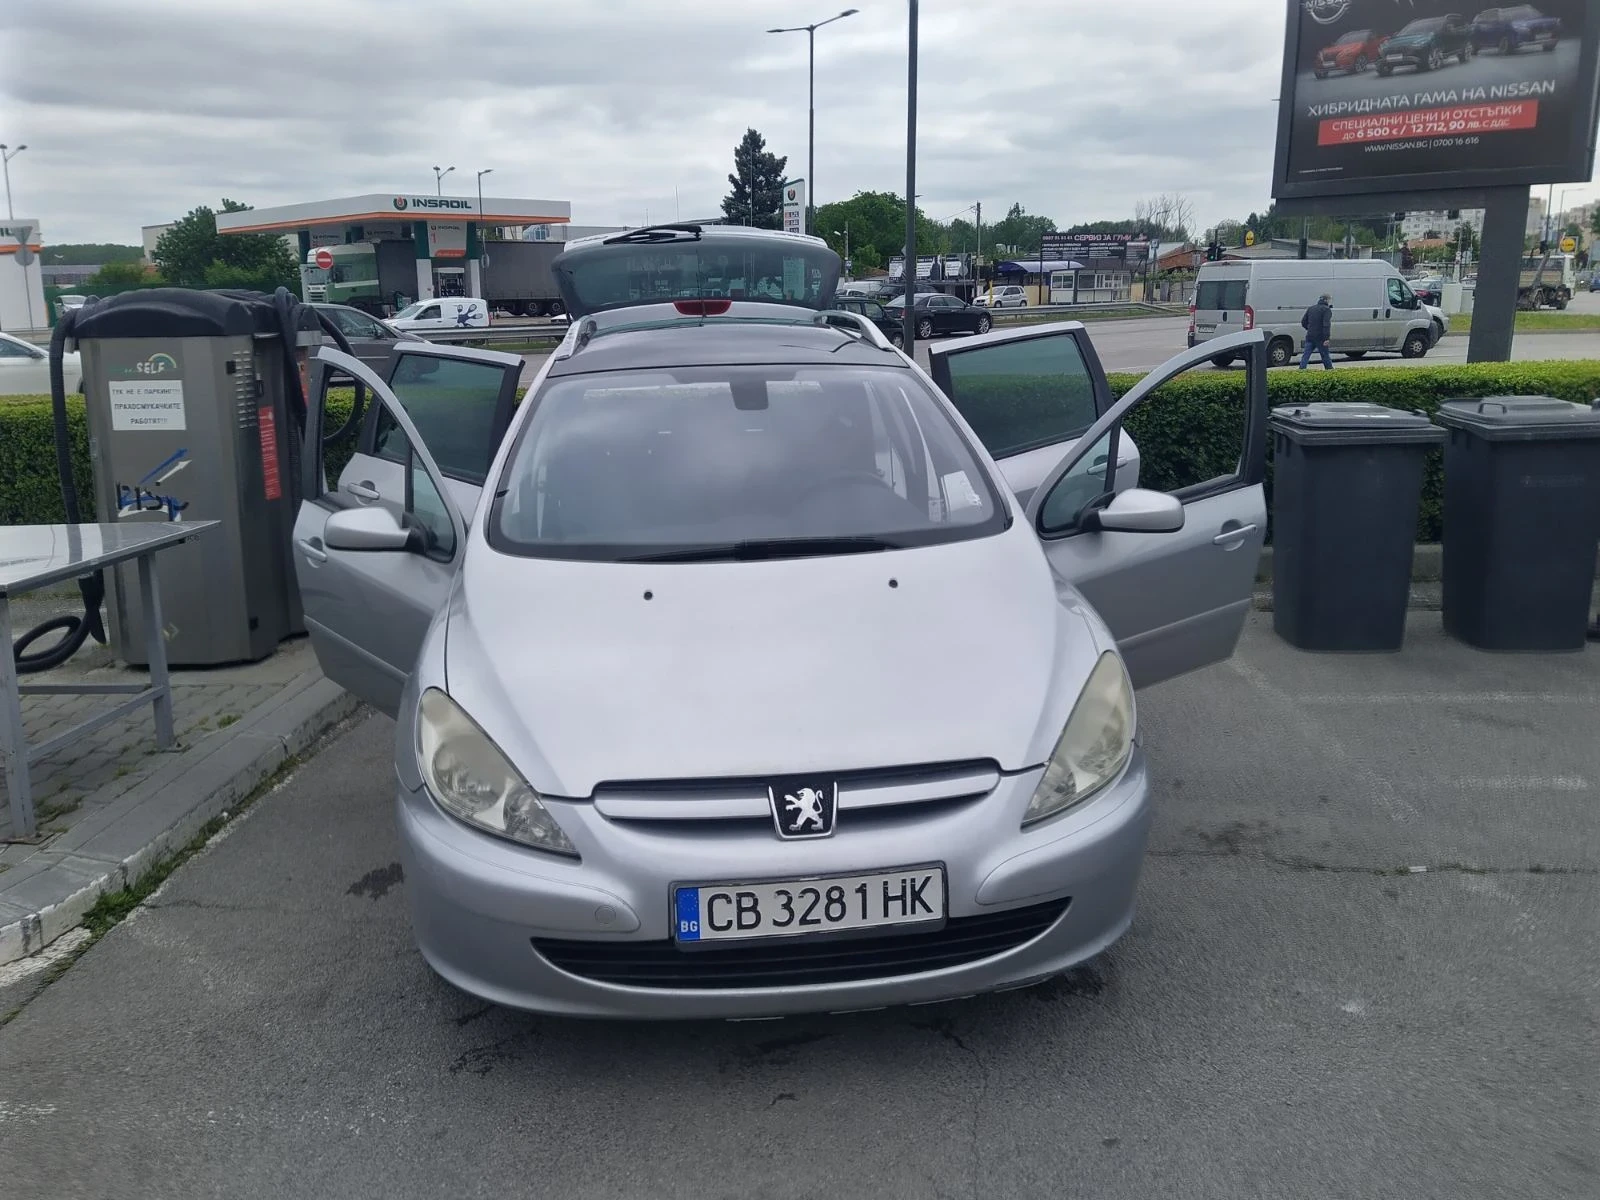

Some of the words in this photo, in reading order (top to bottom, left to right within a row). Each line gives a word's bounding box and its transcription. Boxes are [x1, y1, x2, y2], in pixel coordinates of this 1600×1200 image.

[1308, 95, 1410, 117] ХИБРИДНАТА
[1414, 90, 1458, 106] ГАМА
[1462, 86, 1486, 101] НА
[1490, 79, 1556, 99] NISSAN
[1332, 115, 1403, 132] СПЕЦИАЛНИ
[1405, 112, 1439, 125] ЦЕНИ
[1440, 111, 1450, 121] И
[1452, 104, 1523, 120] ОТСТЪПКИ
[1357, 129, 1364, 138] 6
[1367, 127, 1390, 137] 500
[1410, 123, 1424, 133] 12
[1448, 119, 1466, 130] 90
[1364, 140, 1428, 153] WWW.NISSAN.BG
[1433, 137, 1454, 147] 0700
[411, 198, 472, 209] INSAOIL
[136, 362, 165, 374] SELF
[680, 920, 698, 933] BG
[772, 882, 868, 928] 3281
